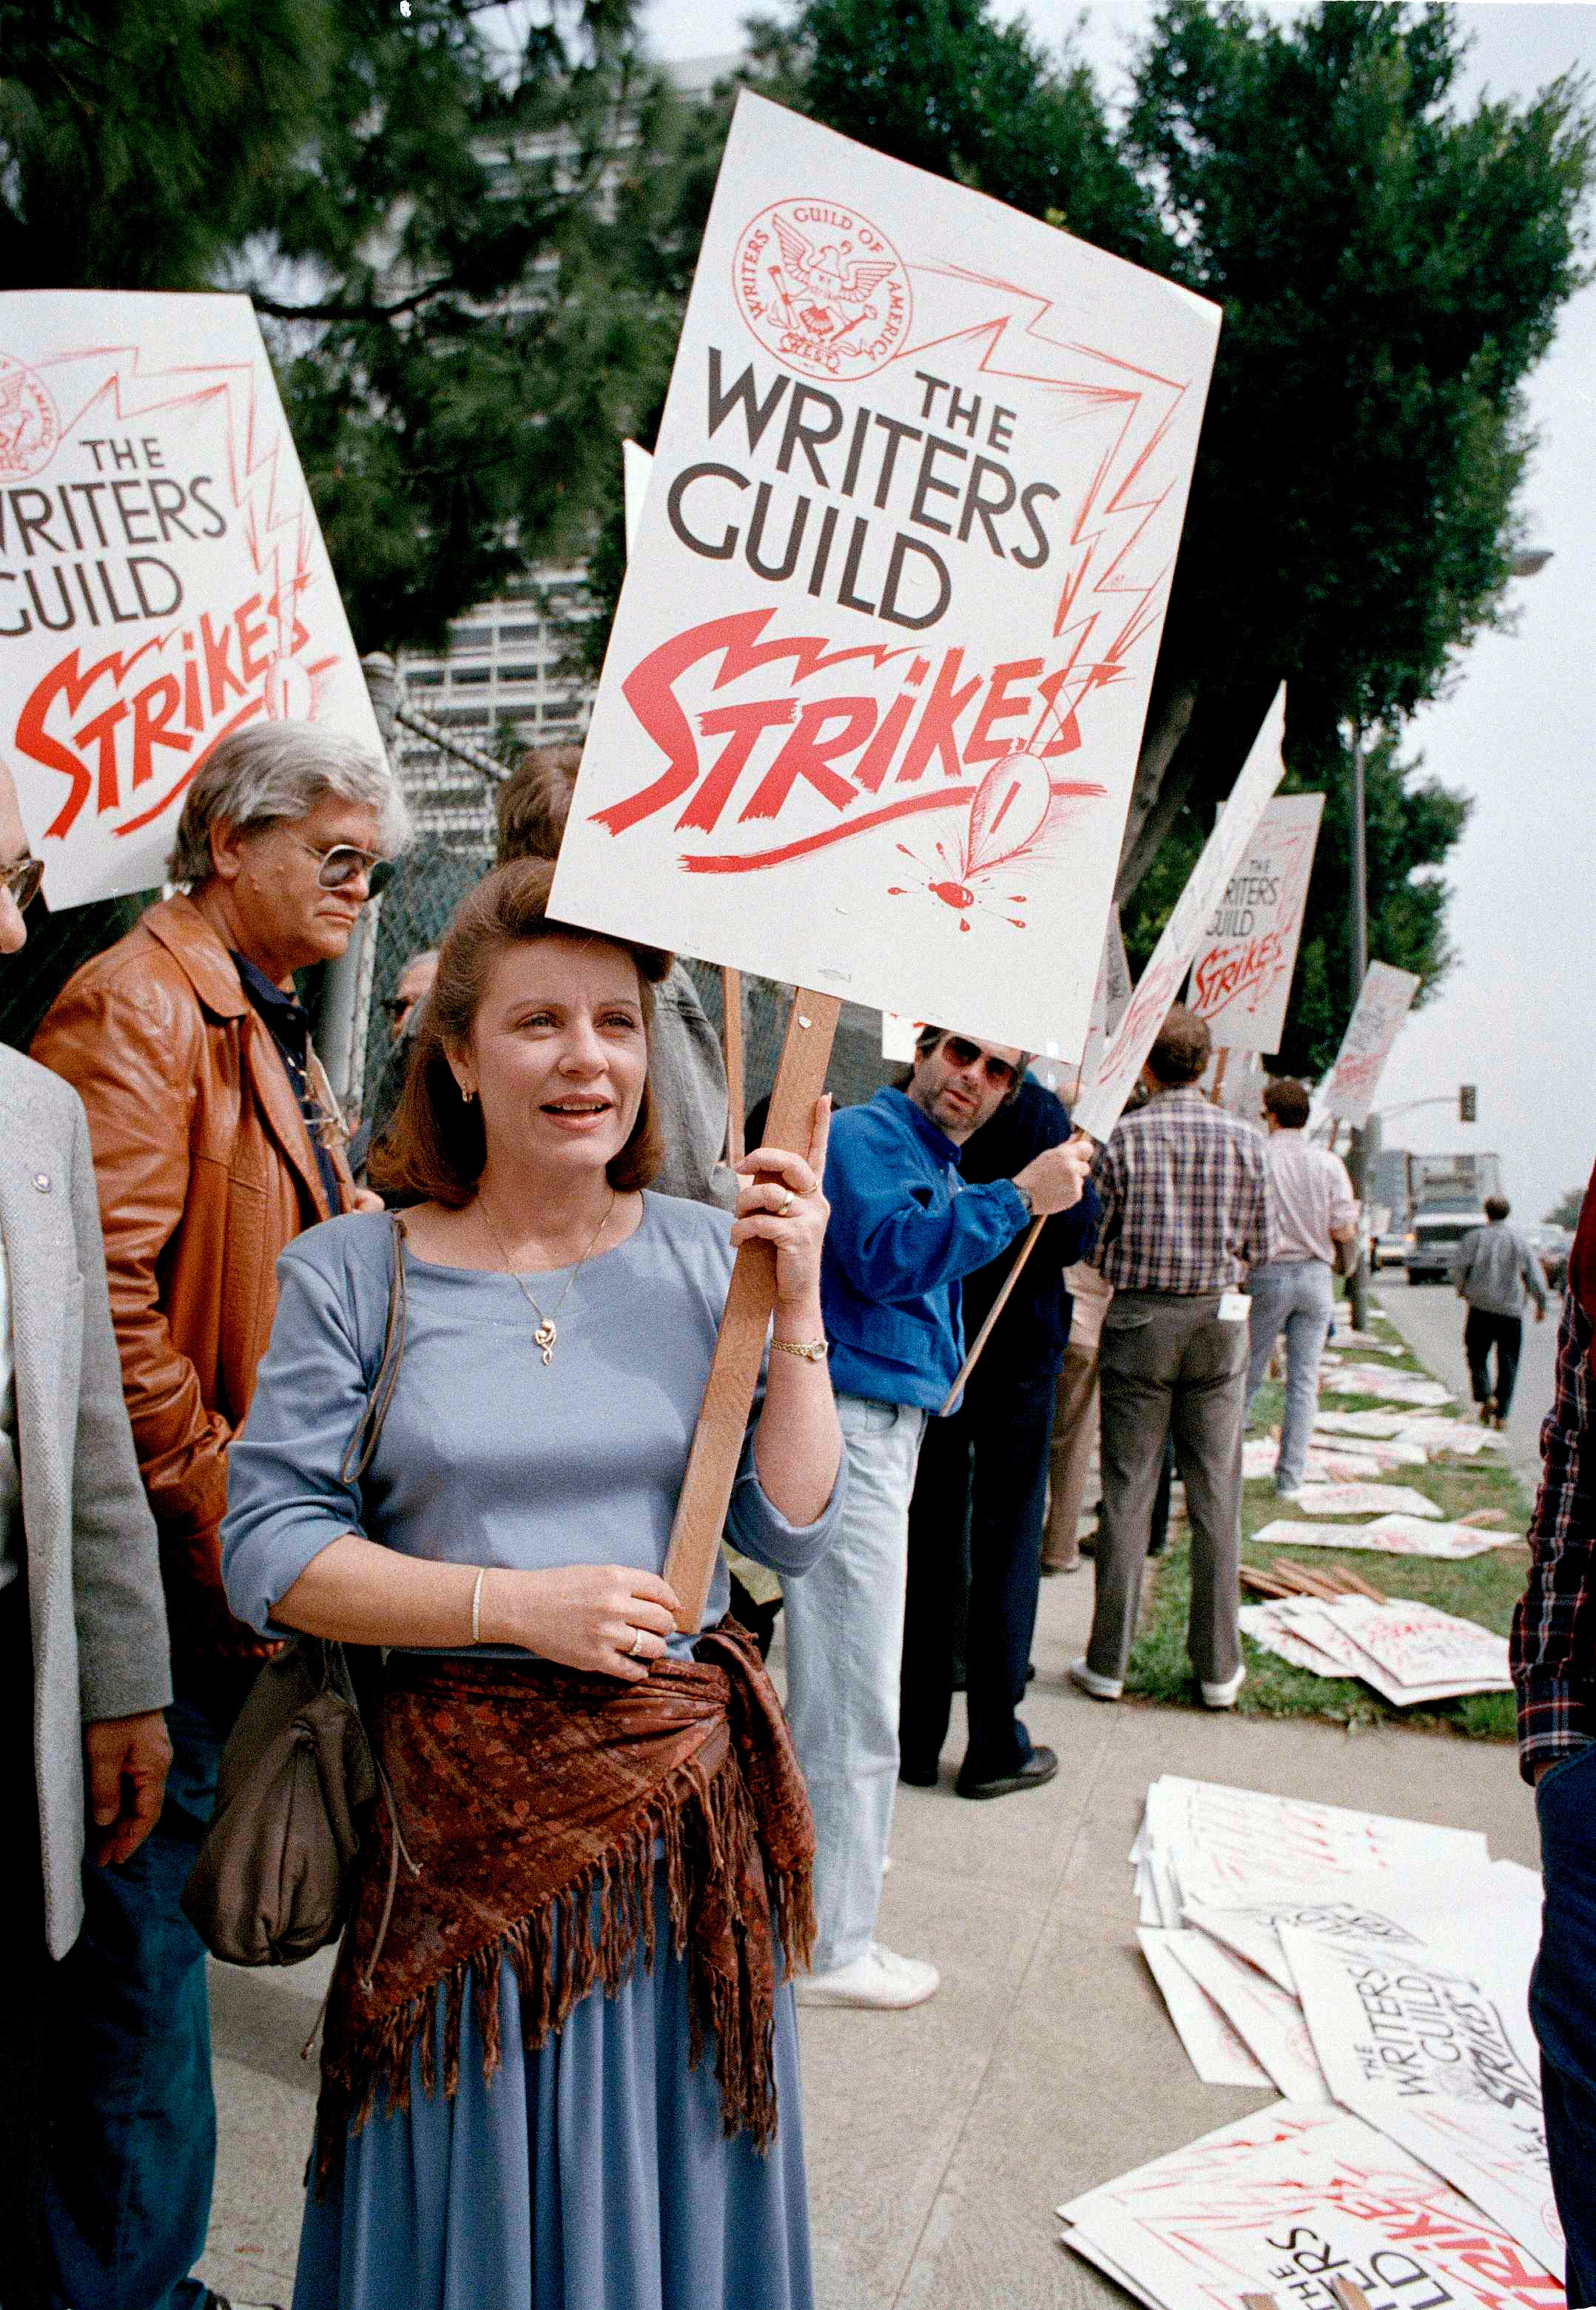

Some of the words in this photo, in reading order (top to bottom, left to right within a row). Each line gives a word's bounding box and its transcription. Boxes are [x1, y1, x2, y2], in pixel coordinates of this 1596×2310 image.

[792, 206, 853, 230] GUILD
[858, 228, 884, 253] OF
[741, 229, 770, 320] WRITERS
[863, 280, 904, 362] AMERICA
[914, 370, 1018, 454] THE
[79, 437, 165, 471] THE
[707, 345, 1061, 570] WRITERS
[0, 475, 227, 556] RITERS
[667, 462, 952, 630] GUILD
[1347, 1968, 1433, 2095] WRITERS
[1396, 1976, 1461, 2063] GUILD
[1354, 2042, 1384, 2081] THE
